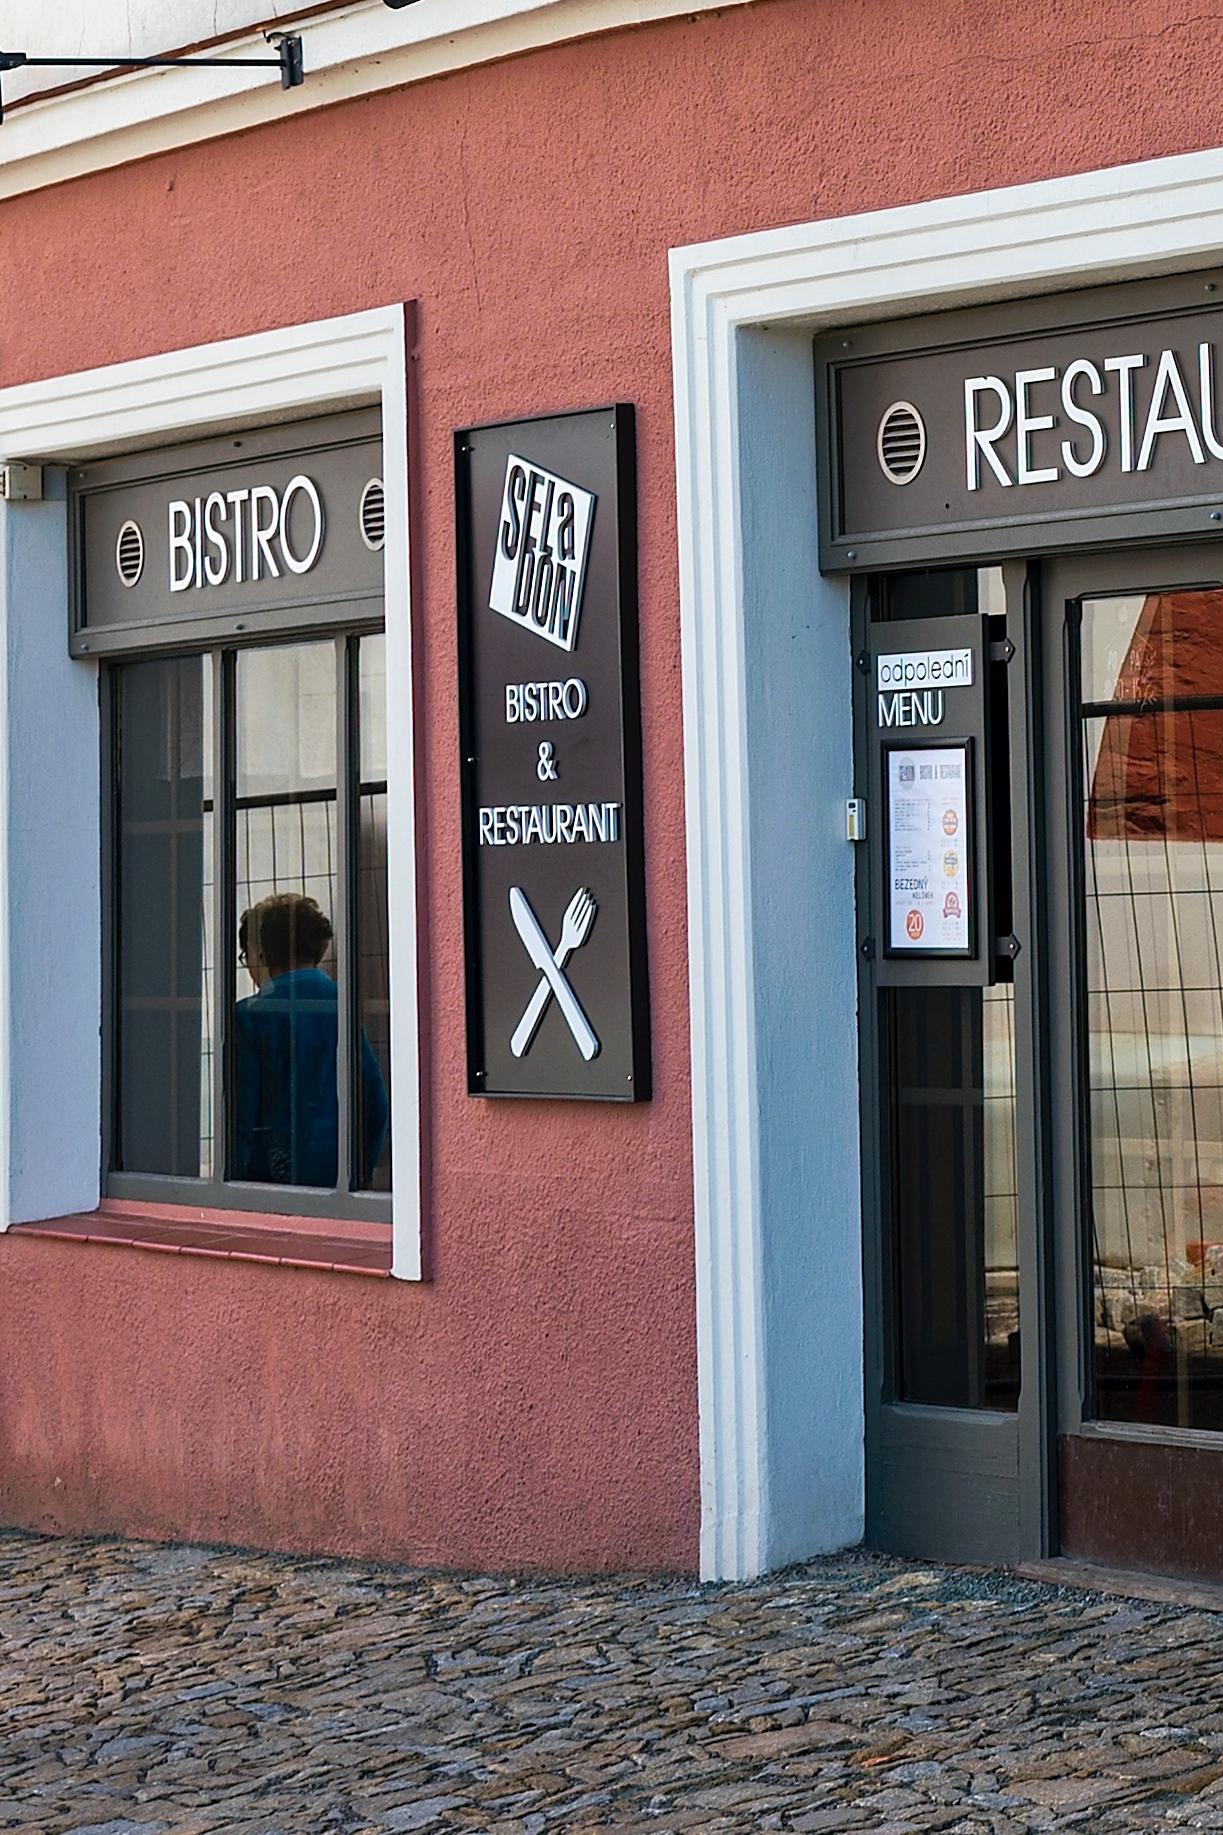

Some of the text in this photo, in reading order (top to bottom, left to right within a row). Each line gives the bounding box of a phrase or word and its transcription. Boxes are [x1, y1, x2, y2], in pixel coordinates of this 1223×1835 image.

[168, 474, 323, 592] BISTRO
[880, 653, 969, 688] odpolední
[505, 678, 588, 723] BISTRO
[878, 690, 943, 727] MENU
[537, 741, 559, 781] &
[479, 802, 622, 845] RESTAURANT
[908, 914, 922, 932] 20
